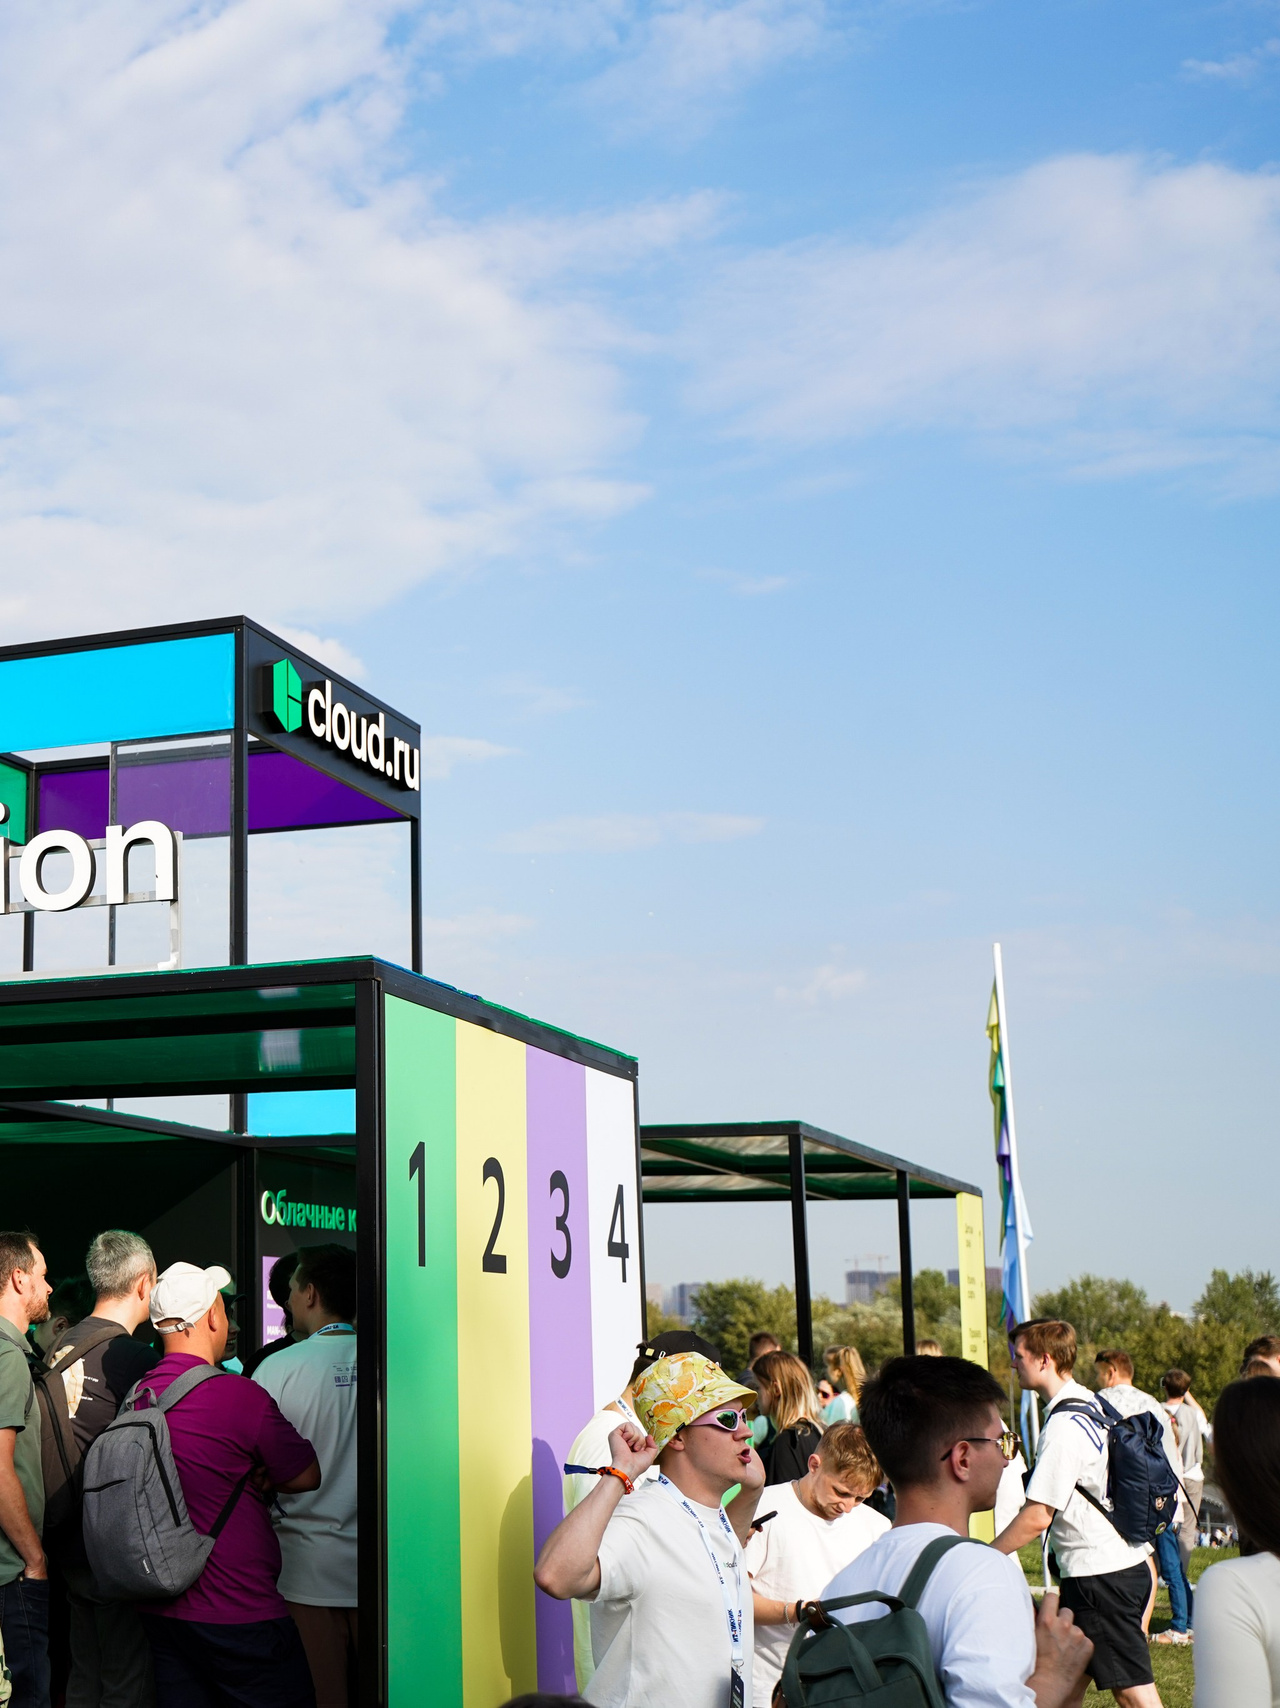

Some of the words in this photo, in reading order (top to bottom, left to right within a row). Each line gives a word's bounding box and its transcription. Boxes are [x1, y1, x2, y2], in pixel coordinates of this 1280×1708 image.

[307, 679, 420, 791] cloud.ru
[261, 1189, 346, 1230] Облачные
[409, 1141, 426, 1267] 1
[483, 1157, 507, 1274] 2
[550, 1170, 571, 1279] 3
[607, 1184, 629, 1283] 4
[727, 1608, 739, 1643] ИТ-ПИКНИК
